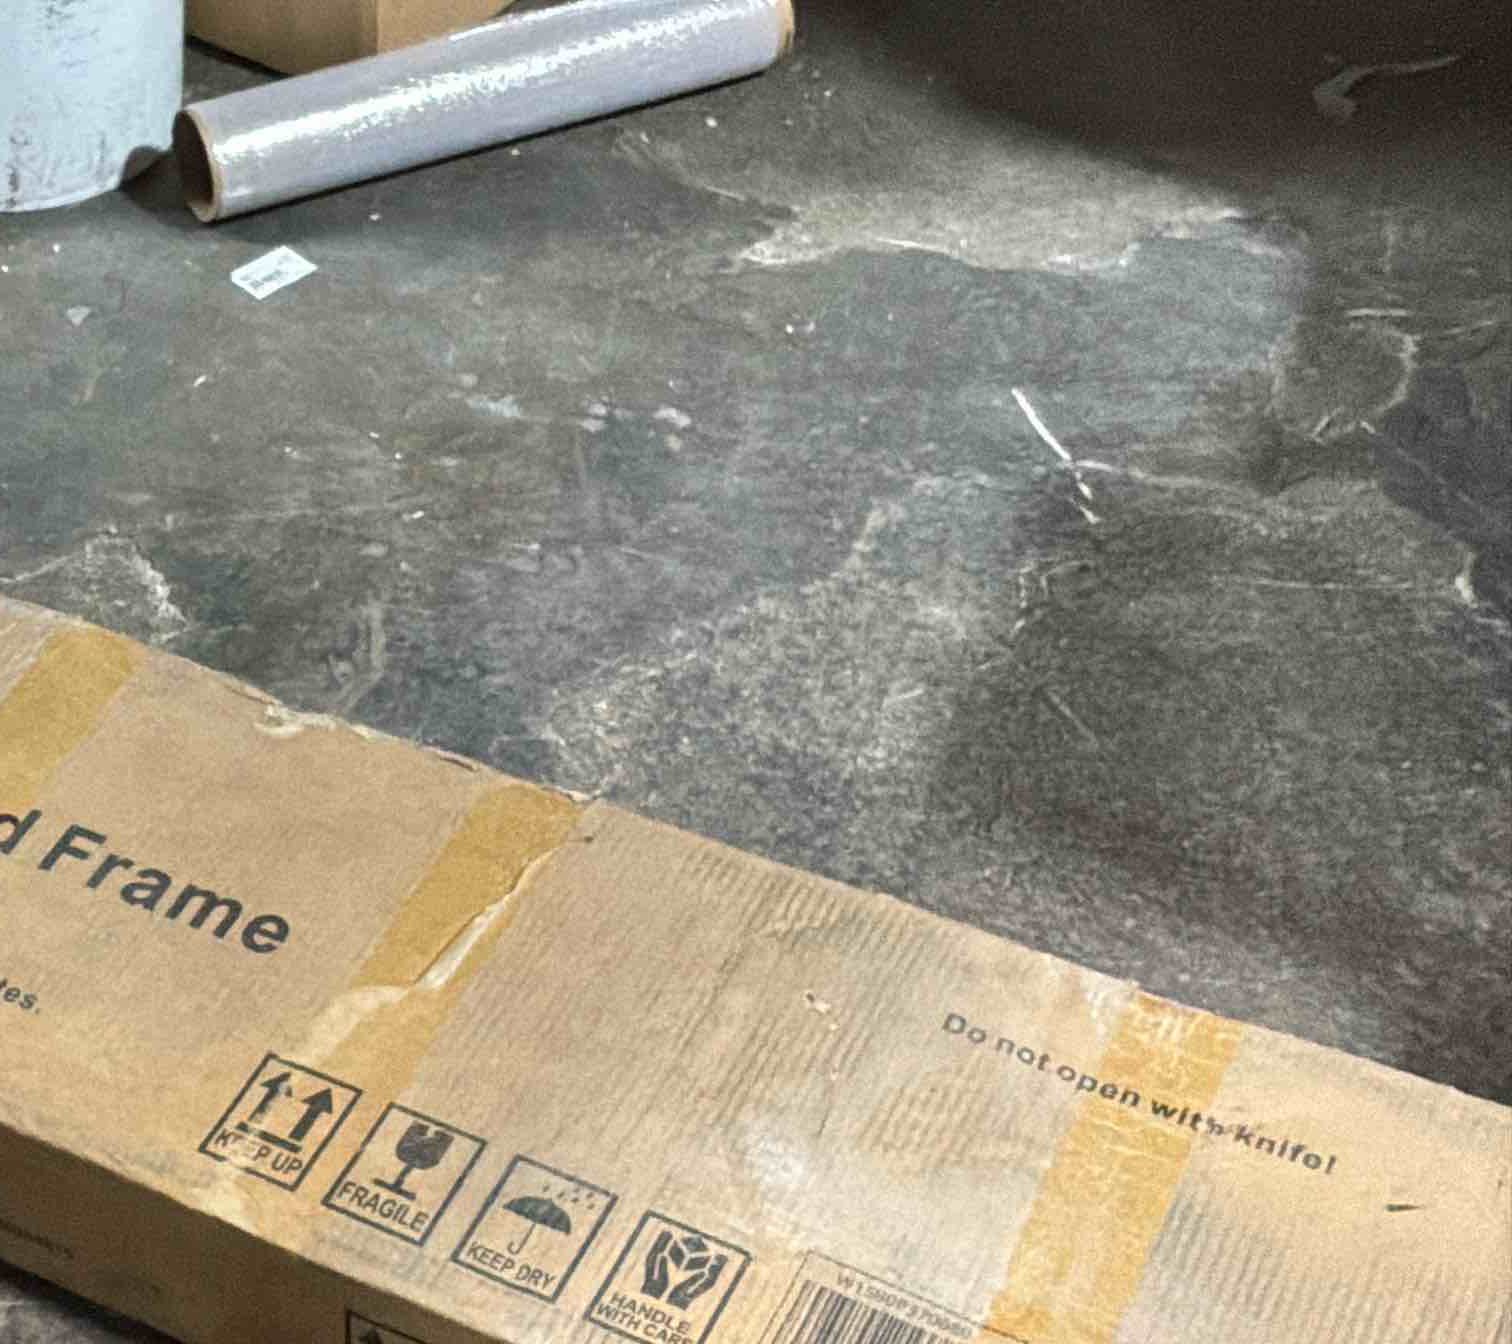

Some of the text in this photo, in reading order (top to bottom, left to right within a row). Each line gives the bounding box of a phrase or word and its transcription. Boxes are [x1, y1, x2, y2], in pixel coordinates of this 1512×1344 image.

[38, 823, 290, 955] Frame
[942, 1012, 1338, 1176] Do not open with knife!
[214, 1128, 304, 1176] KP UP
[337, 1181, 430, 1232] FRAGILE
[467, 1241, 557, 1291] KEEP DRY
[596, 1302, 641, 1332] WITH
[609, 1291, 692, 1335] HANDLE
